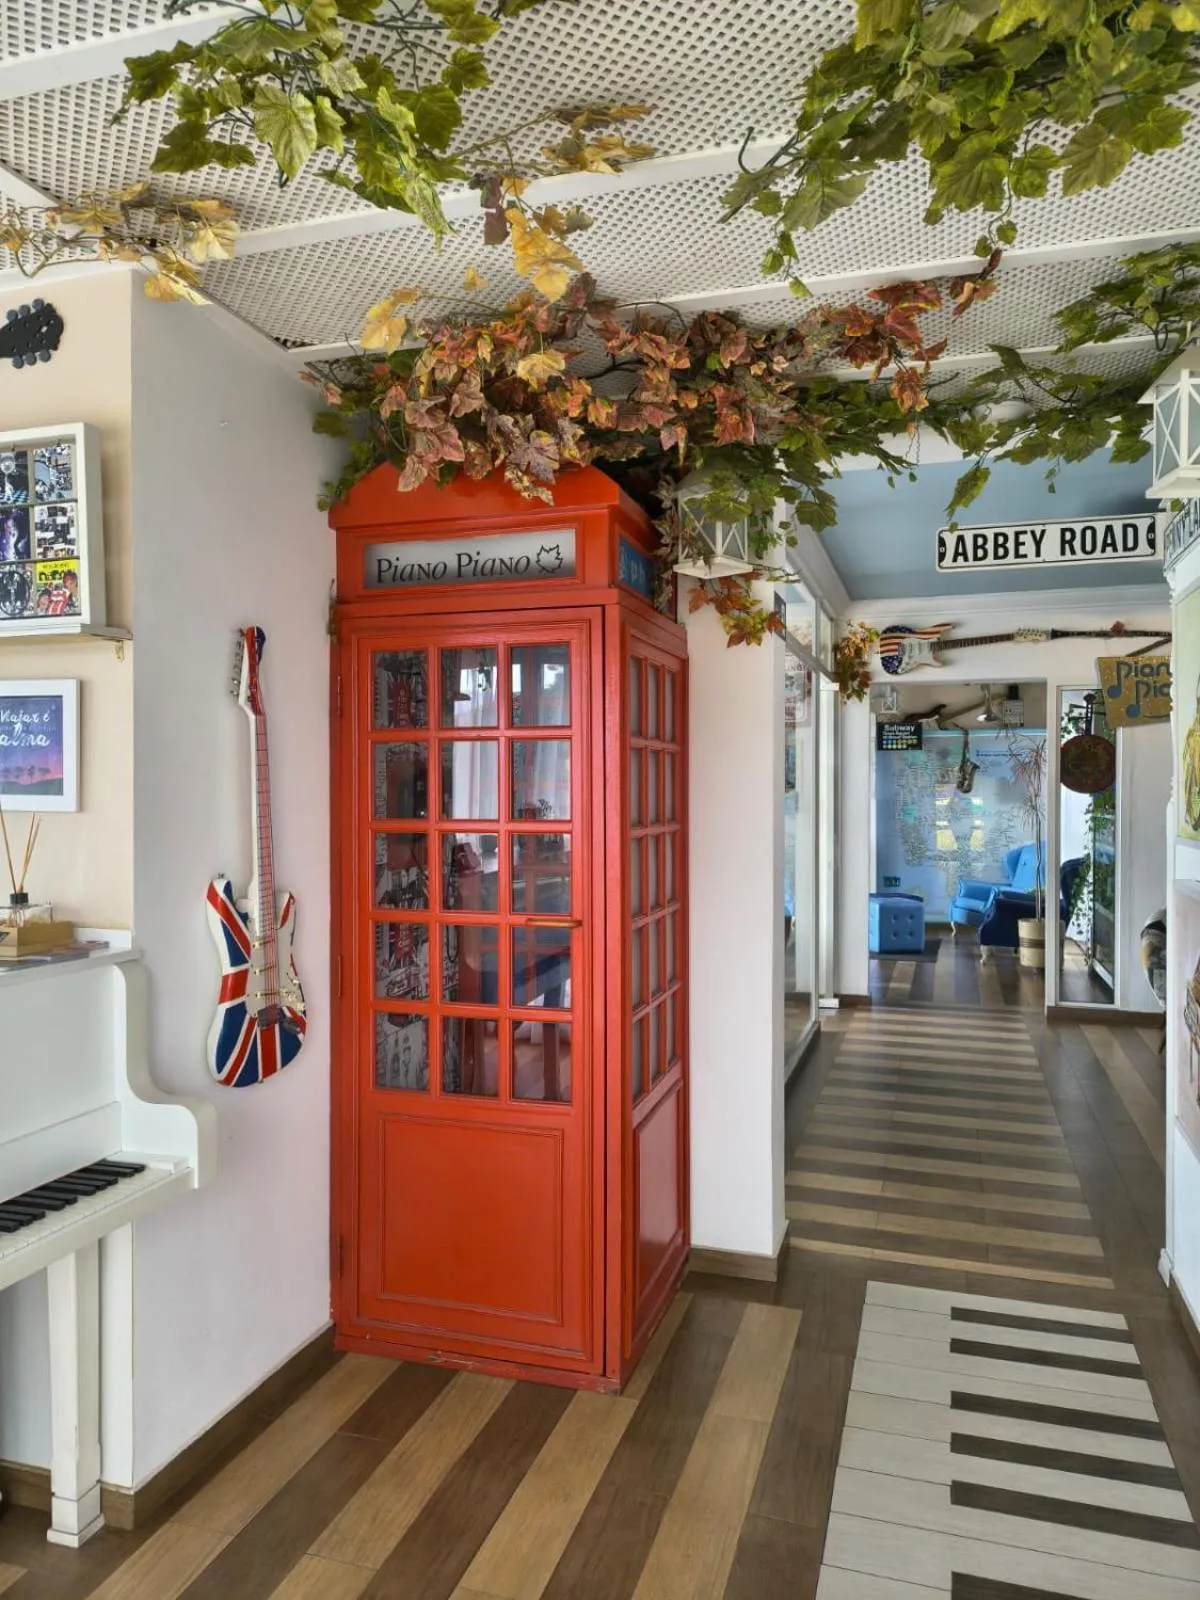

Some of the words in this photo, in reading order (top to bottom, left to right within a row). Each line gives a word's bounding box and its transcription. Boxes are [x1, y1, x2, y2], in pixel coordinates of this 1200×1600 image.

[952, 528, 1046, 562] ABBEY
[1060, 523, 1139, 556] ROAD
[884, 724, 915, 732] Subway
